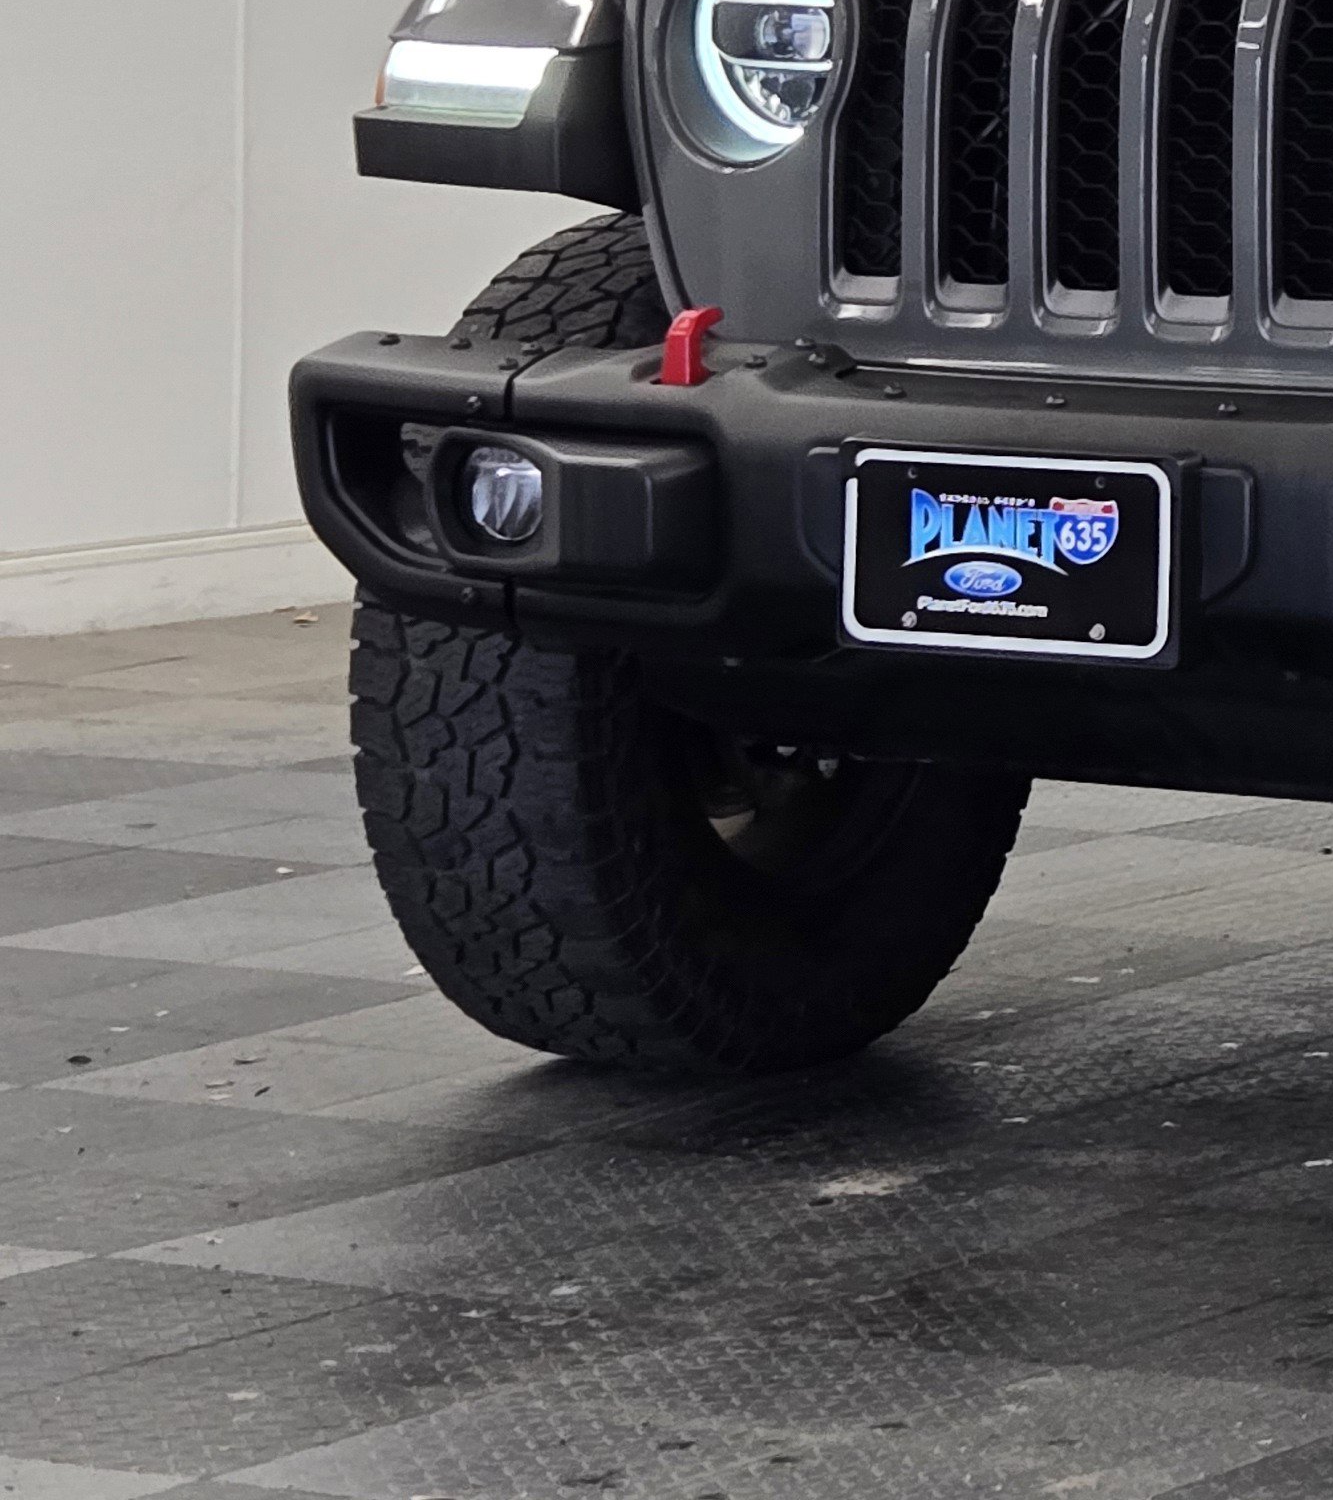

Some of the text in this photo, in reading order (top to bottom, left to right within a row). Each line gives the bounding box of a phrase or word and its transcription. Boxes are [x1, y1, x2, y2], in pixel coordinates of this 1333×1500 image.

[910, 488, 1108, 567] PLANET 635
[959, 568, 1008, 592] Ford
